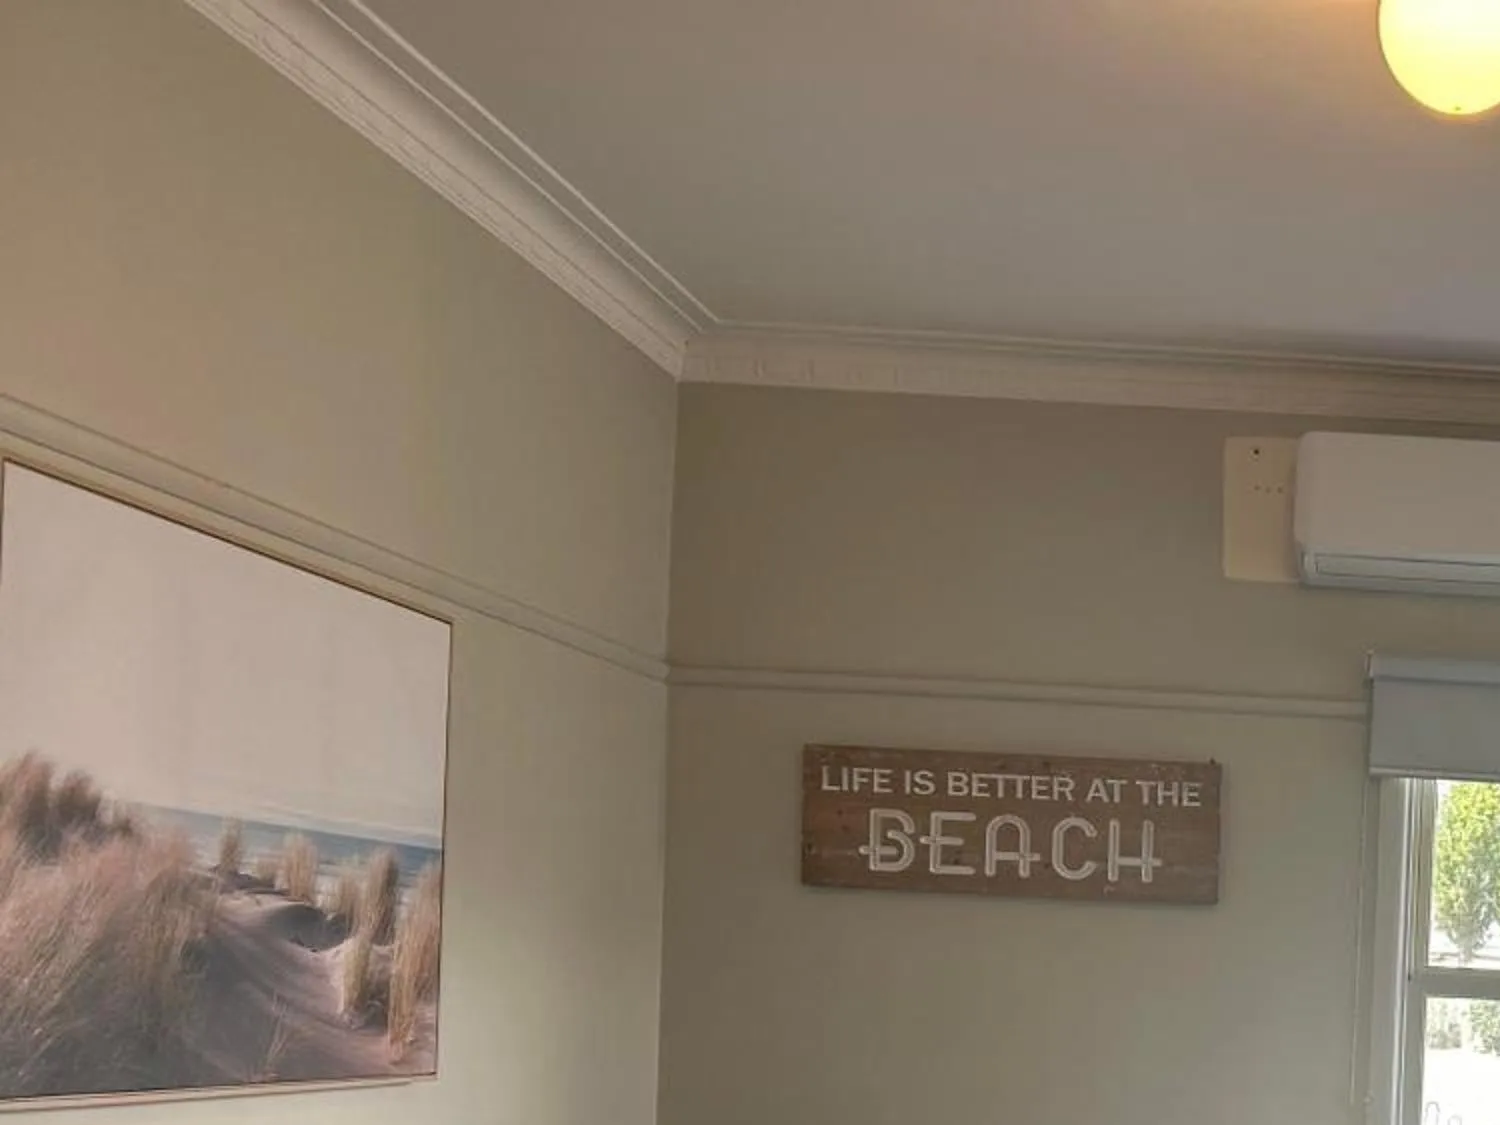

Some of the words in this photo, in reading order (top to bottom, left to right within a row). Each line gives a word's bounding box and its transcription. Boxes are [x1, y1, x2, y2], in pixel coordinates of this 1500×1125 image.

[821, 765, 893, 794] LIFE
[904, 770, 937, 796] IS
[947, 770, 1076, 802] BETTER
[1086, 779, 1128, 804] AT
[1135, 780, 1203, 808] THE
[858, 807, 1163, 884] BEACH
